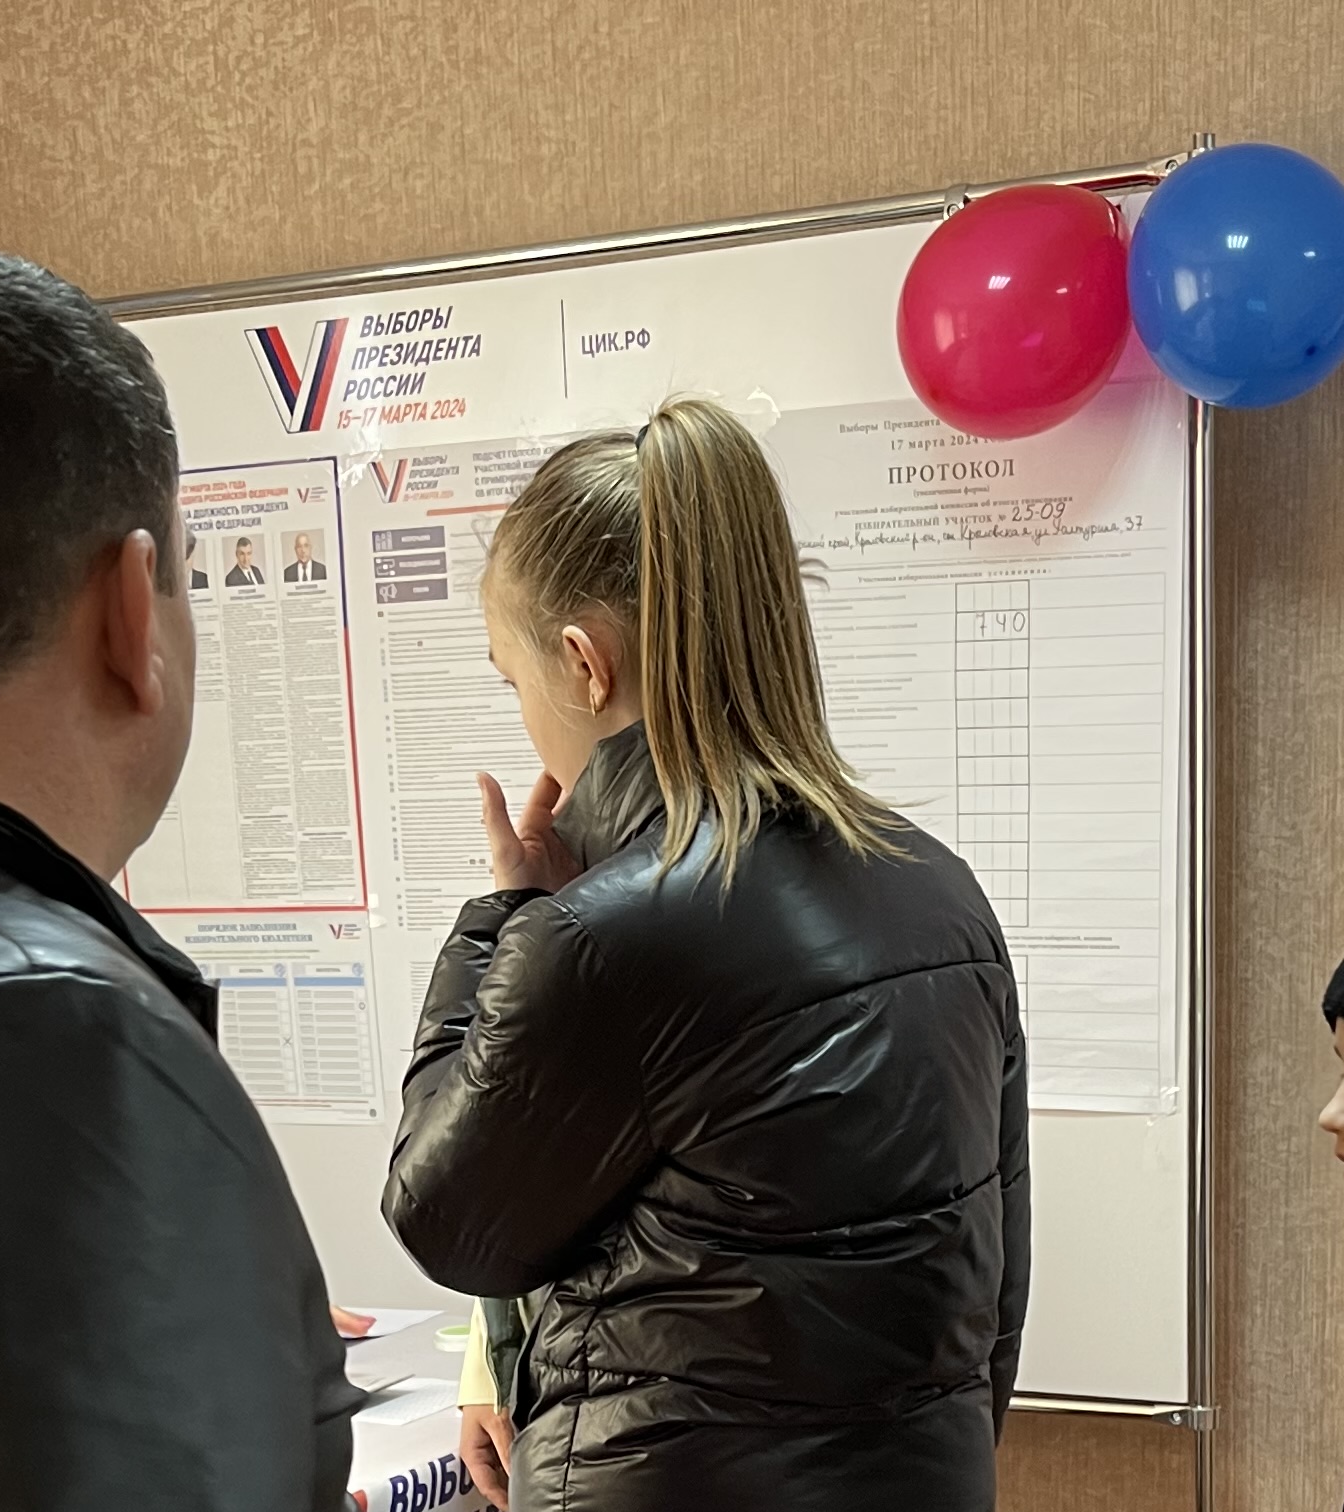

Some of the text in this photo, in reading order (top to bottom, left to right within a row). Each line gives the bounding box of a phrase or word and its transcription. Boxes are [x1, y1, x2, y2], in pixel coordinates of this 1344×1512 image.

[360, 306, 453, 338] ВЫБОРЫ
[351, 334, 482, 370] ПРЕЗИДЕНТА
[581, 328, 651, 358] ЦИК.РФ
[343, 372, 426, 401] РОССИИ
[378, 402, 428, 424] МАРТА
[431, 398, 466, 420] 2024
[839, 419, 941, 434] Выборы Президента
[891, 440, 903, 450] 17
[908, 438, 945, 451] марта
[888, 458, 1015, 484] ПРОТОКОЛ
[1012, 502, 1066, 522] 25-09
[1124, 515, 1143, 531] 37
